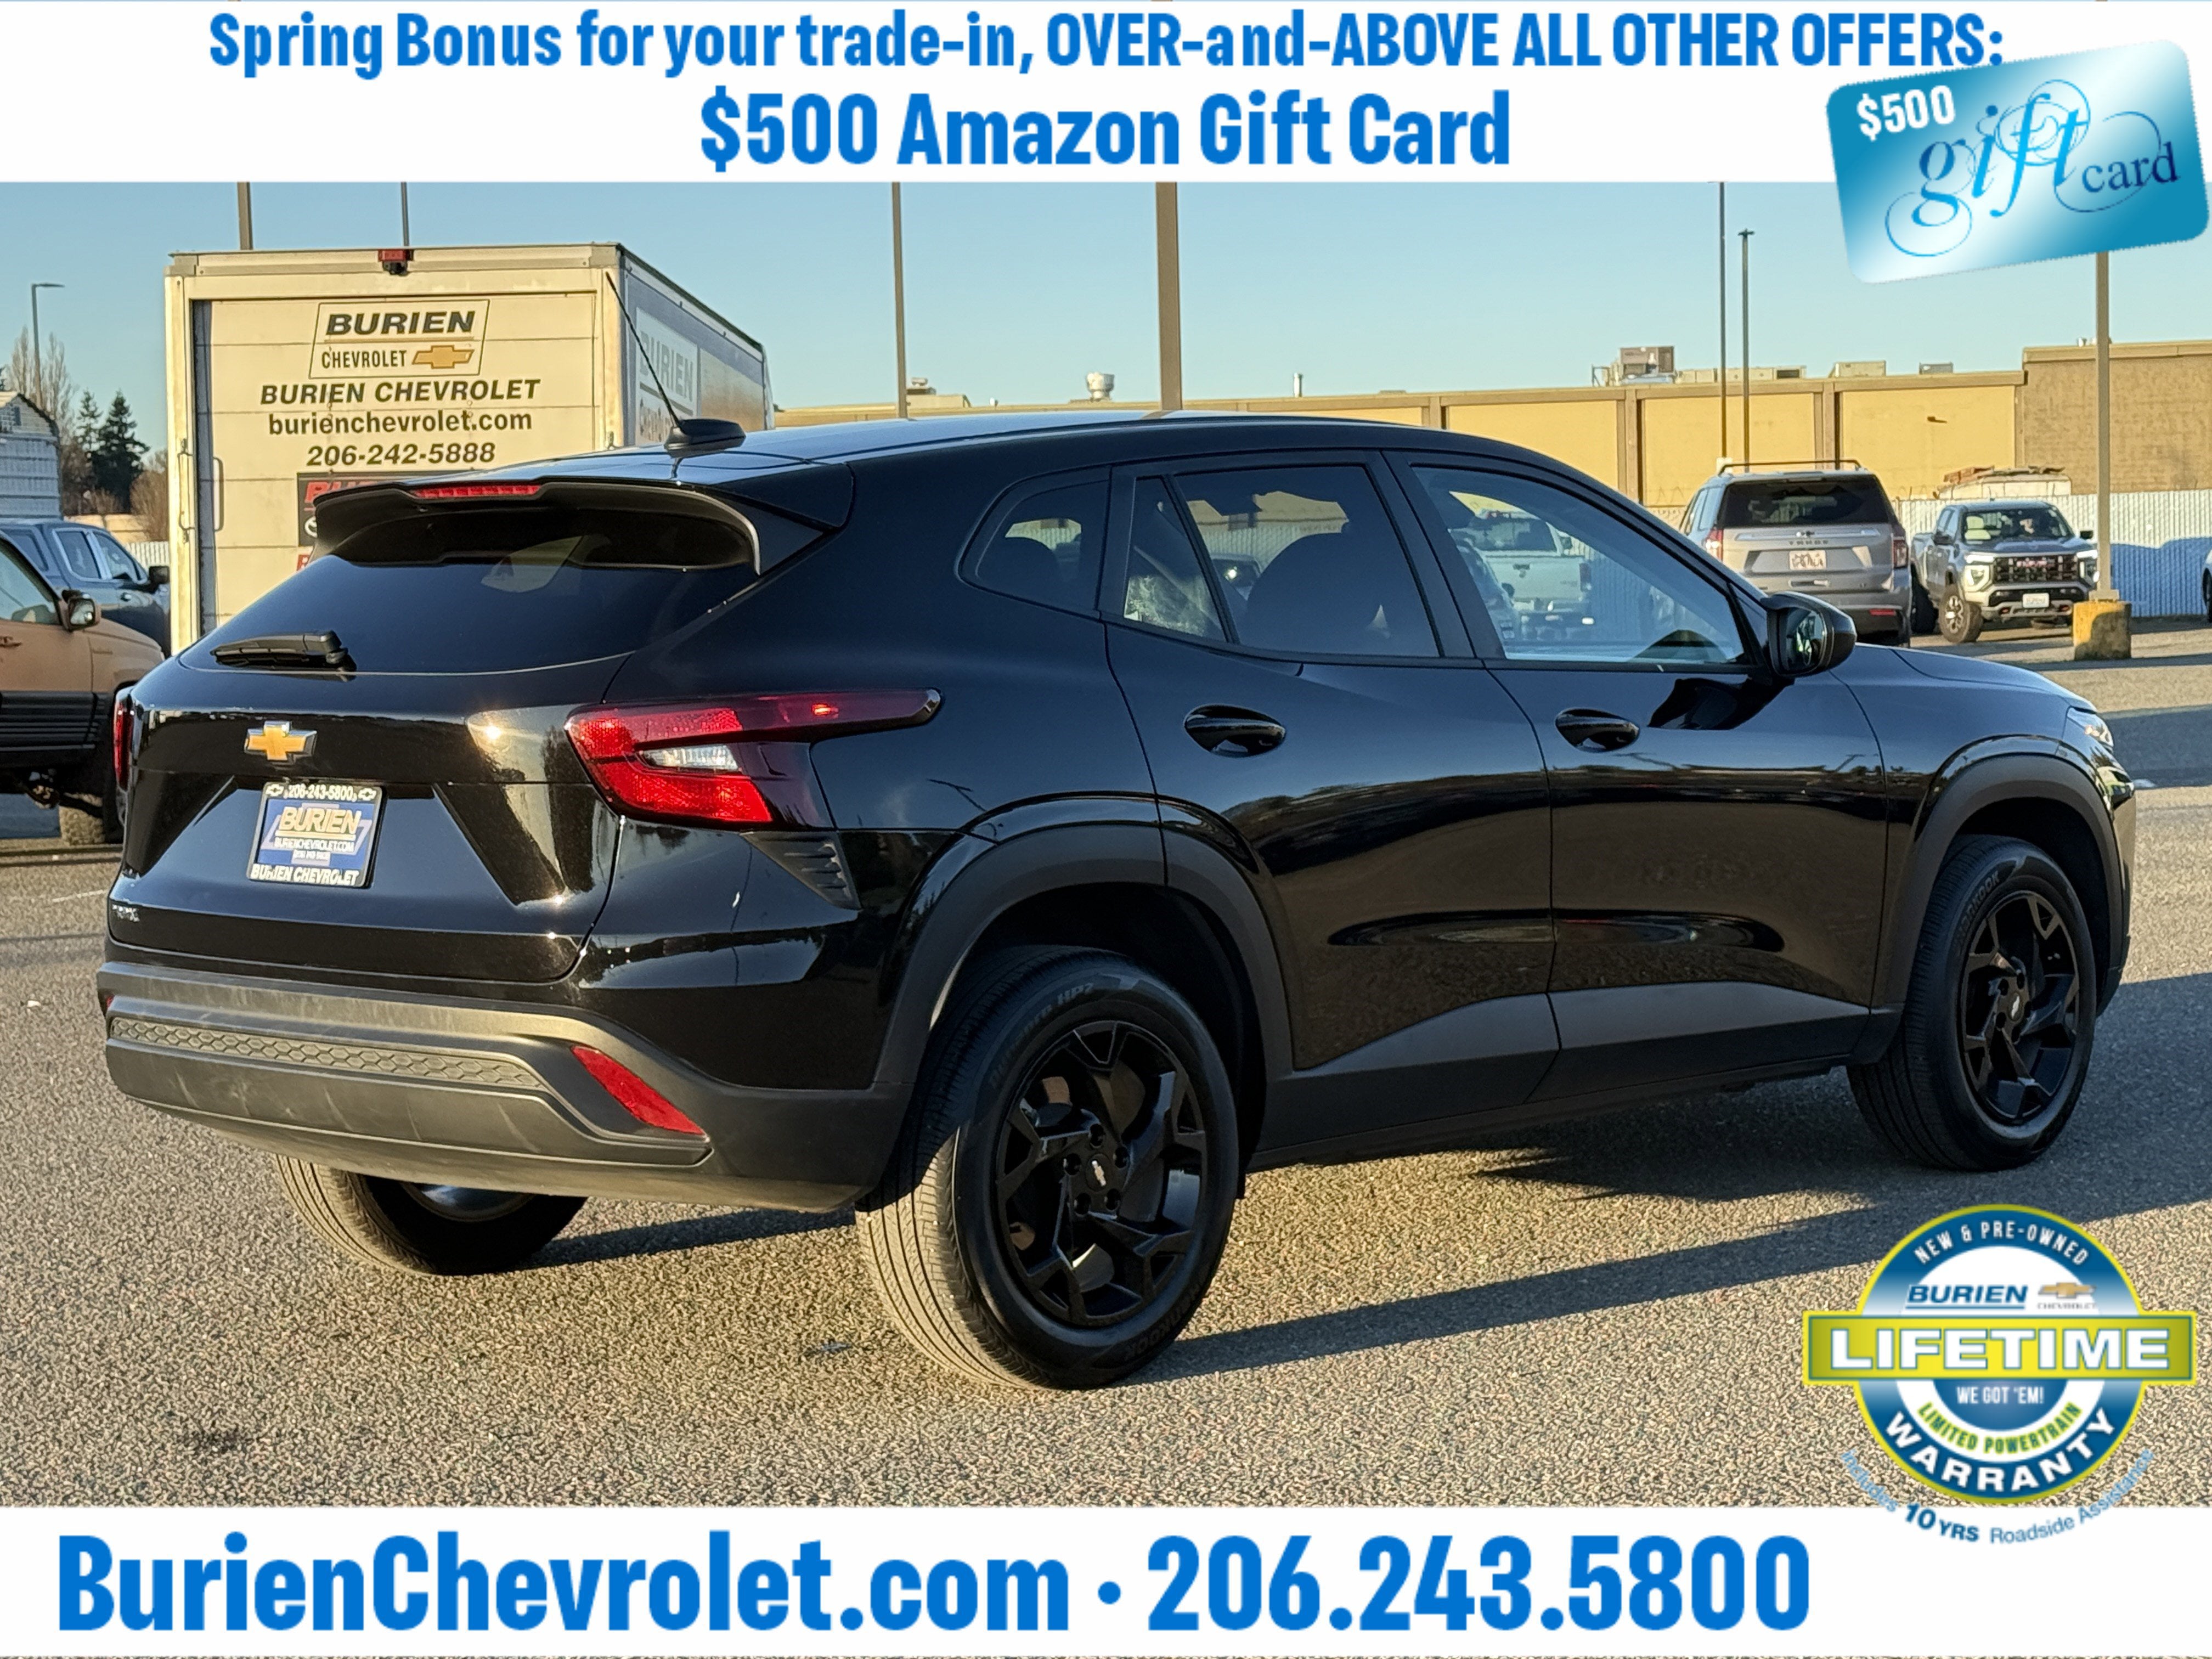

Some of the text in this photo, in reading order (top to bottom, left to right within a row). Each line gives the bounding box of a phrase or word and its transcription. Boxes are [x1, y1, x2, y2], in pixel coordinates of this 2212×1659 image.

[326, 311, 475, 336] BURIEN
[321, 349, 407, 369] CHEVROLET
[261, 379, 541, 404] BURIEN CHEVROLET
[269, 410, 532, 435] burienchevrolet.com
[307, 442, 495, 466] 206-242-5888
[288, 784, 354, 799] 206-243-5800
[279, 806, 362, 834] BURIEN
[251, 864, 359, 886] BURIEN CHEVROLET
